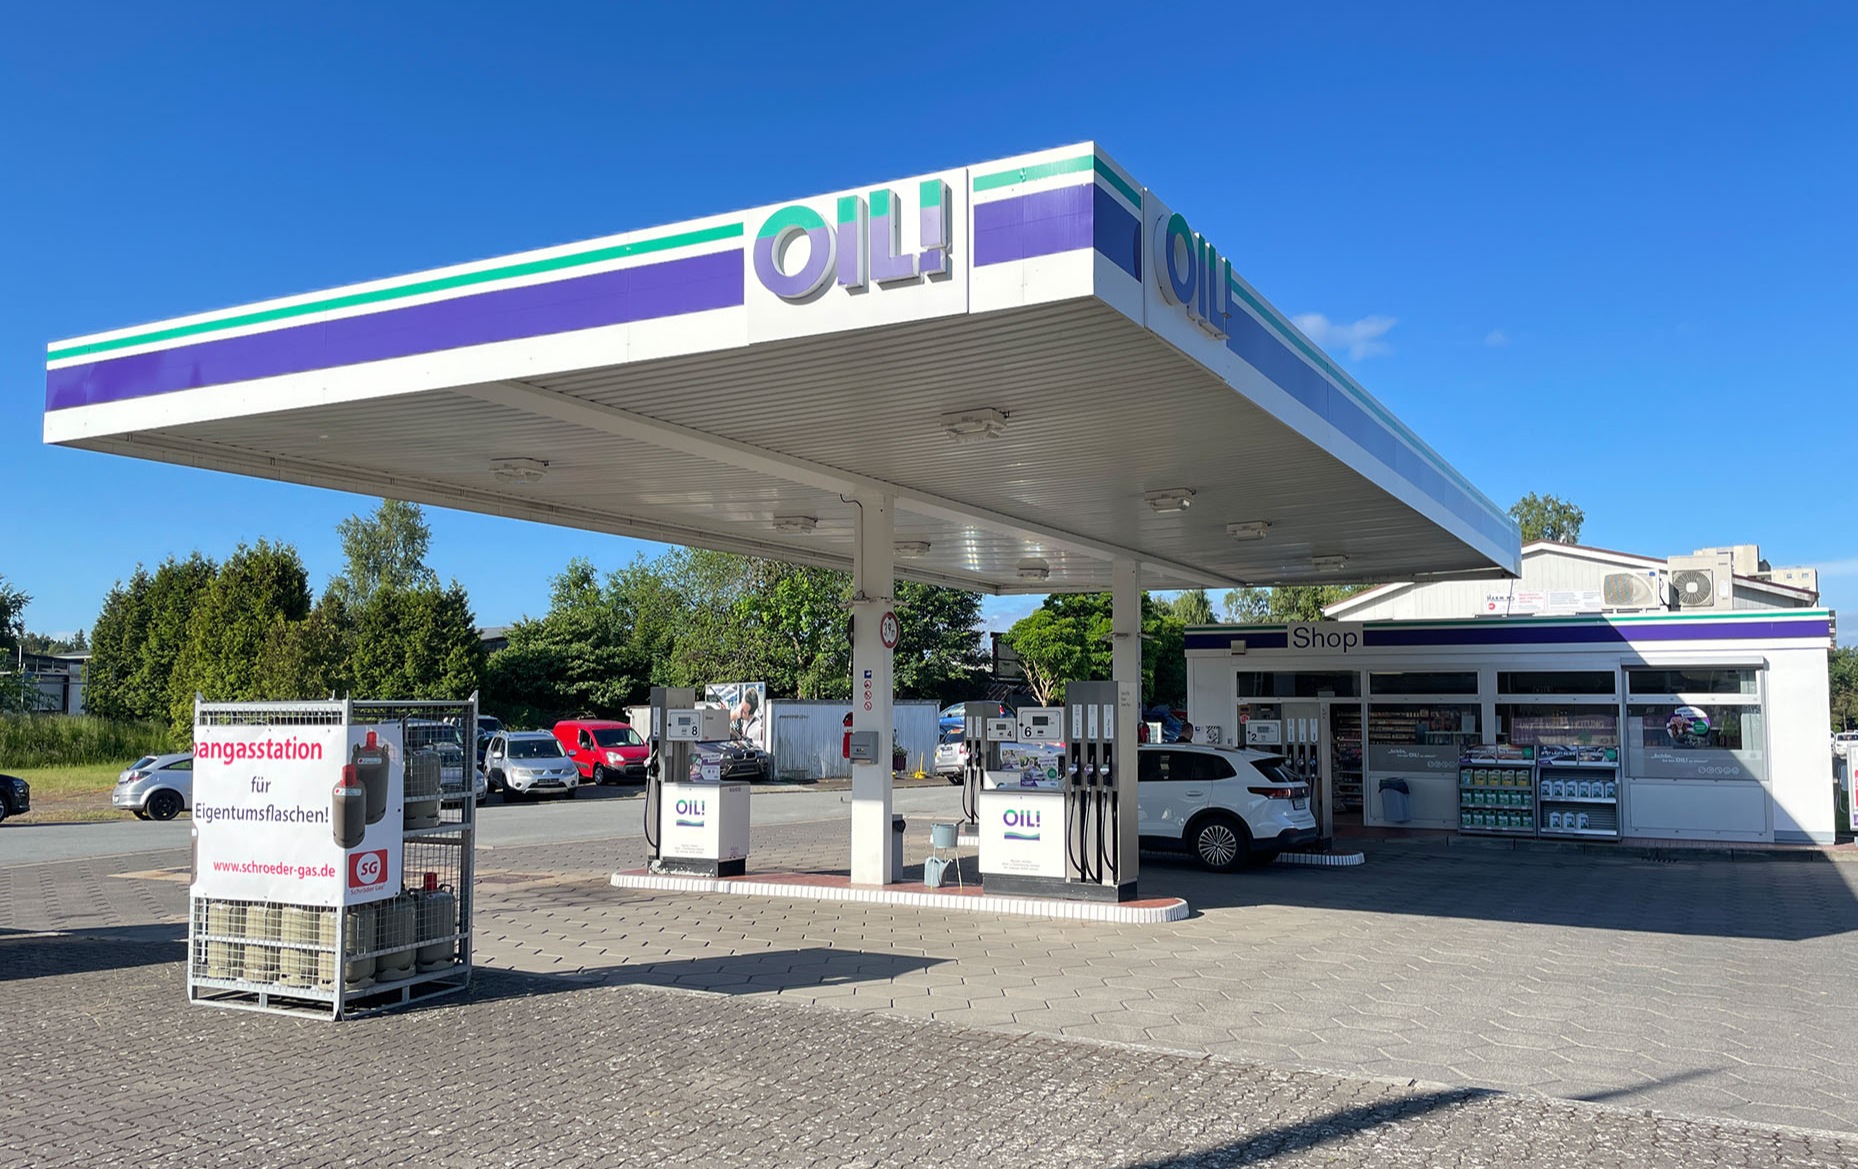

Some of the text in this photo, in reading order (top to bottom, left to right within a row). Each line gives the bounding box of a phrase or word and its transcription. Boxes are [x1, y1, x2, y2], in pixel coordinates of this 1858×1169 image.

[753, 178, 946, 299] OIL!
[1292, 627, 1358, 653] Shop
[692, 726, 698, 736] 8
[1007, 730, 1012, 738] 4
[1024, 726, 1032, 737] 6
[1251, 733, 1257, 742] 2
[251, 776, 272, 793] für
[195, 803, 329, 824] Eigentumsflaschen!
[676, 799, 705, 816] OIL!
[1003, 809, 1041, 828] OIL!
[213, 860, 336, 880] www.schroeder-gas.de
[360, 861, 378, 876] SG
